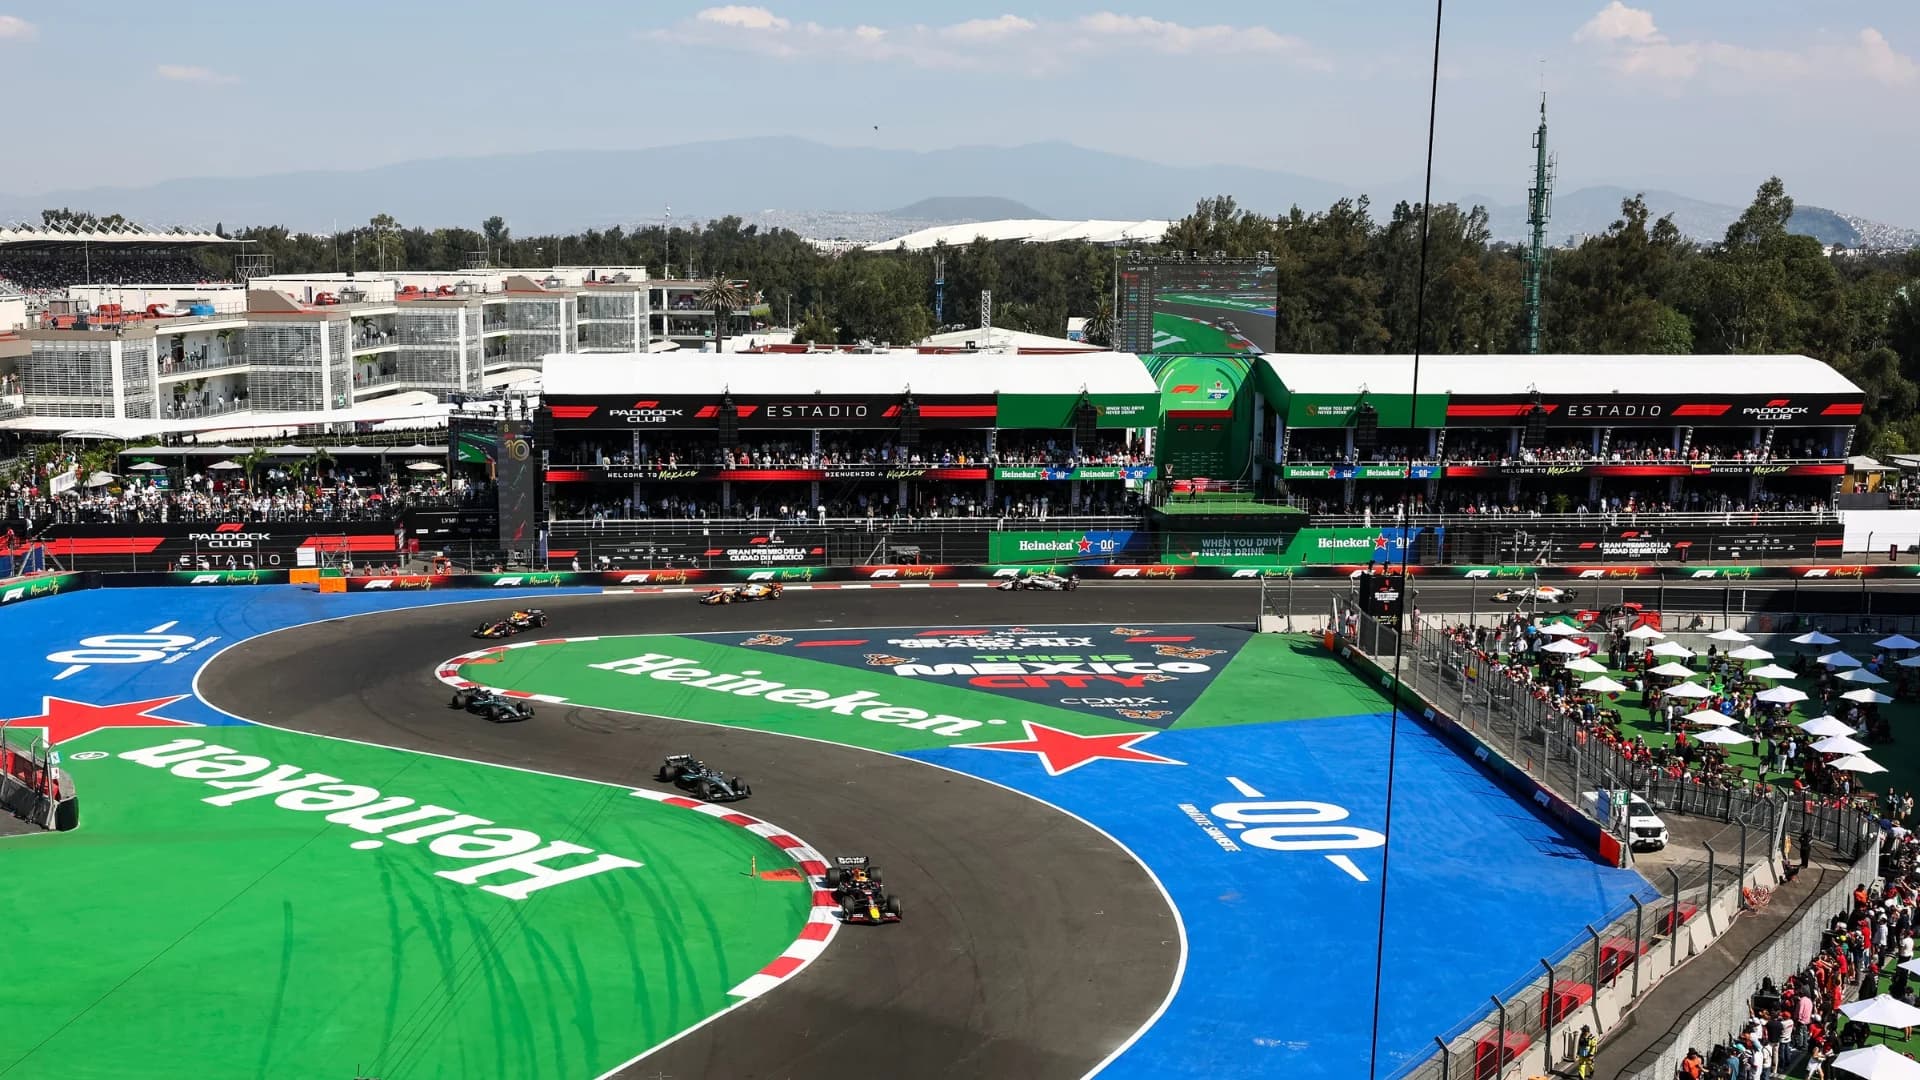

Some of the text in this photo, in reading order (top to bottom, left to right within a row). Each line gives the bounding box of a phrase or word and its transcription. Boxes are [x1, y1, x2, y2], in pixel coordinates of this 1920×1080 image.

[767, 406, 867, 417] ESTADIO
[1568, 405, 1662, 416] ESTADIO
[658, 471, 698, 479] Mexico
[886, 470, 926, 479] Mexico
[1547, 465, 1584, 476] Mexico
[1752, 465, 1790, 475] Mexico
[1019, 541, 1073, 550] Heineken
[1202, 539, 1230, 547] WHEN
[1318, 538, 1371, 548] Heineken
[1202, 547, 1264, 556] NEVER DRINK
[182, 554, 281, 566] ESTADIO
[247, 570, 259, 584] City
[675, 571, 687, 584] City
[802, 568, 812, 582] City
[923, 566, 934, 579] City
[1164, 566, 1176, 579] City
[1282, 566, 1293, 578] City
[1515, 567, 1525, 580] City
[1628, 567, 1638, 580] City
[1739, 567, 1750, 580] City
[1852, 566, 1863, 579] City
[420, 576, 432, 591] City
[549, 574, 561, 588] City
[48, 580, 59, 596] City
[894, 662, 1212, 676] MEXICO
[967, 675, 1146, 688] CITY
[588, 652, 988, 737] Heineken
[117, 738, 646, 900] Heineken
